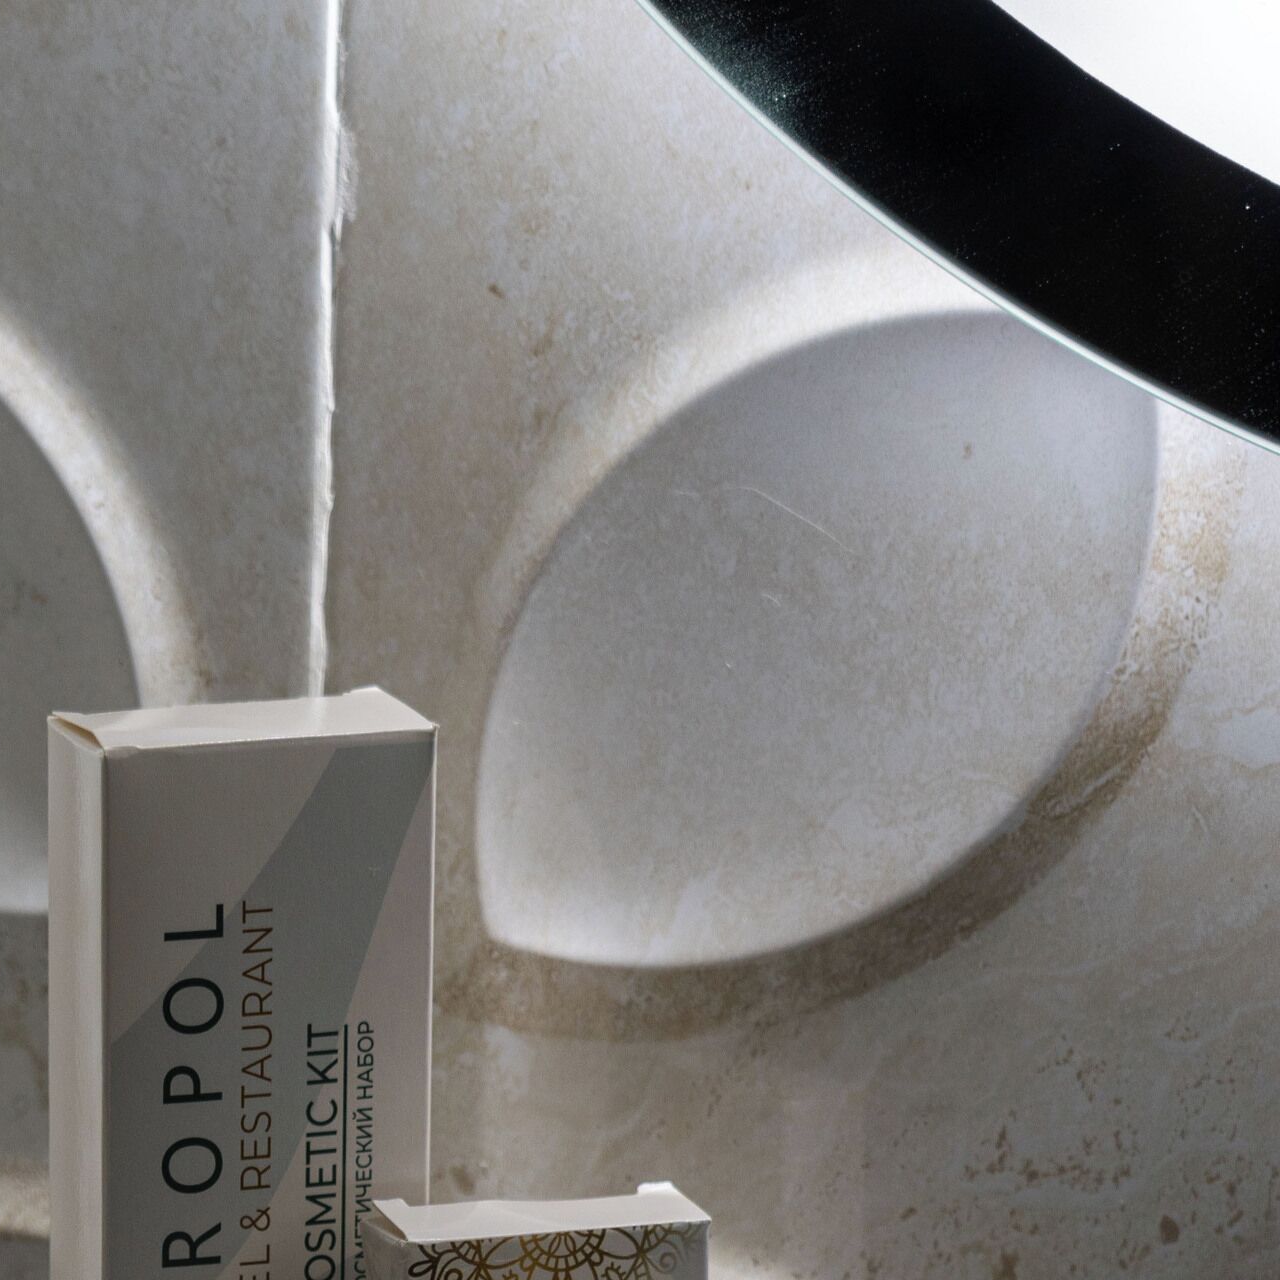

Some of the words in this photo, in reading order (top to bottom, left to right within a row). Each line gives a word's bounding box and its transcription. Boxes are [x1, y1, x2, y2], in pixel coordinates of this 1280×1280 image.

[240, 901, 273, 1191] RESTAURANT
[307, 1024, 339, 1086] KIT
[357, 1020, 375, 1099] НАБОР
[240, 1207, 271, 1231] &
